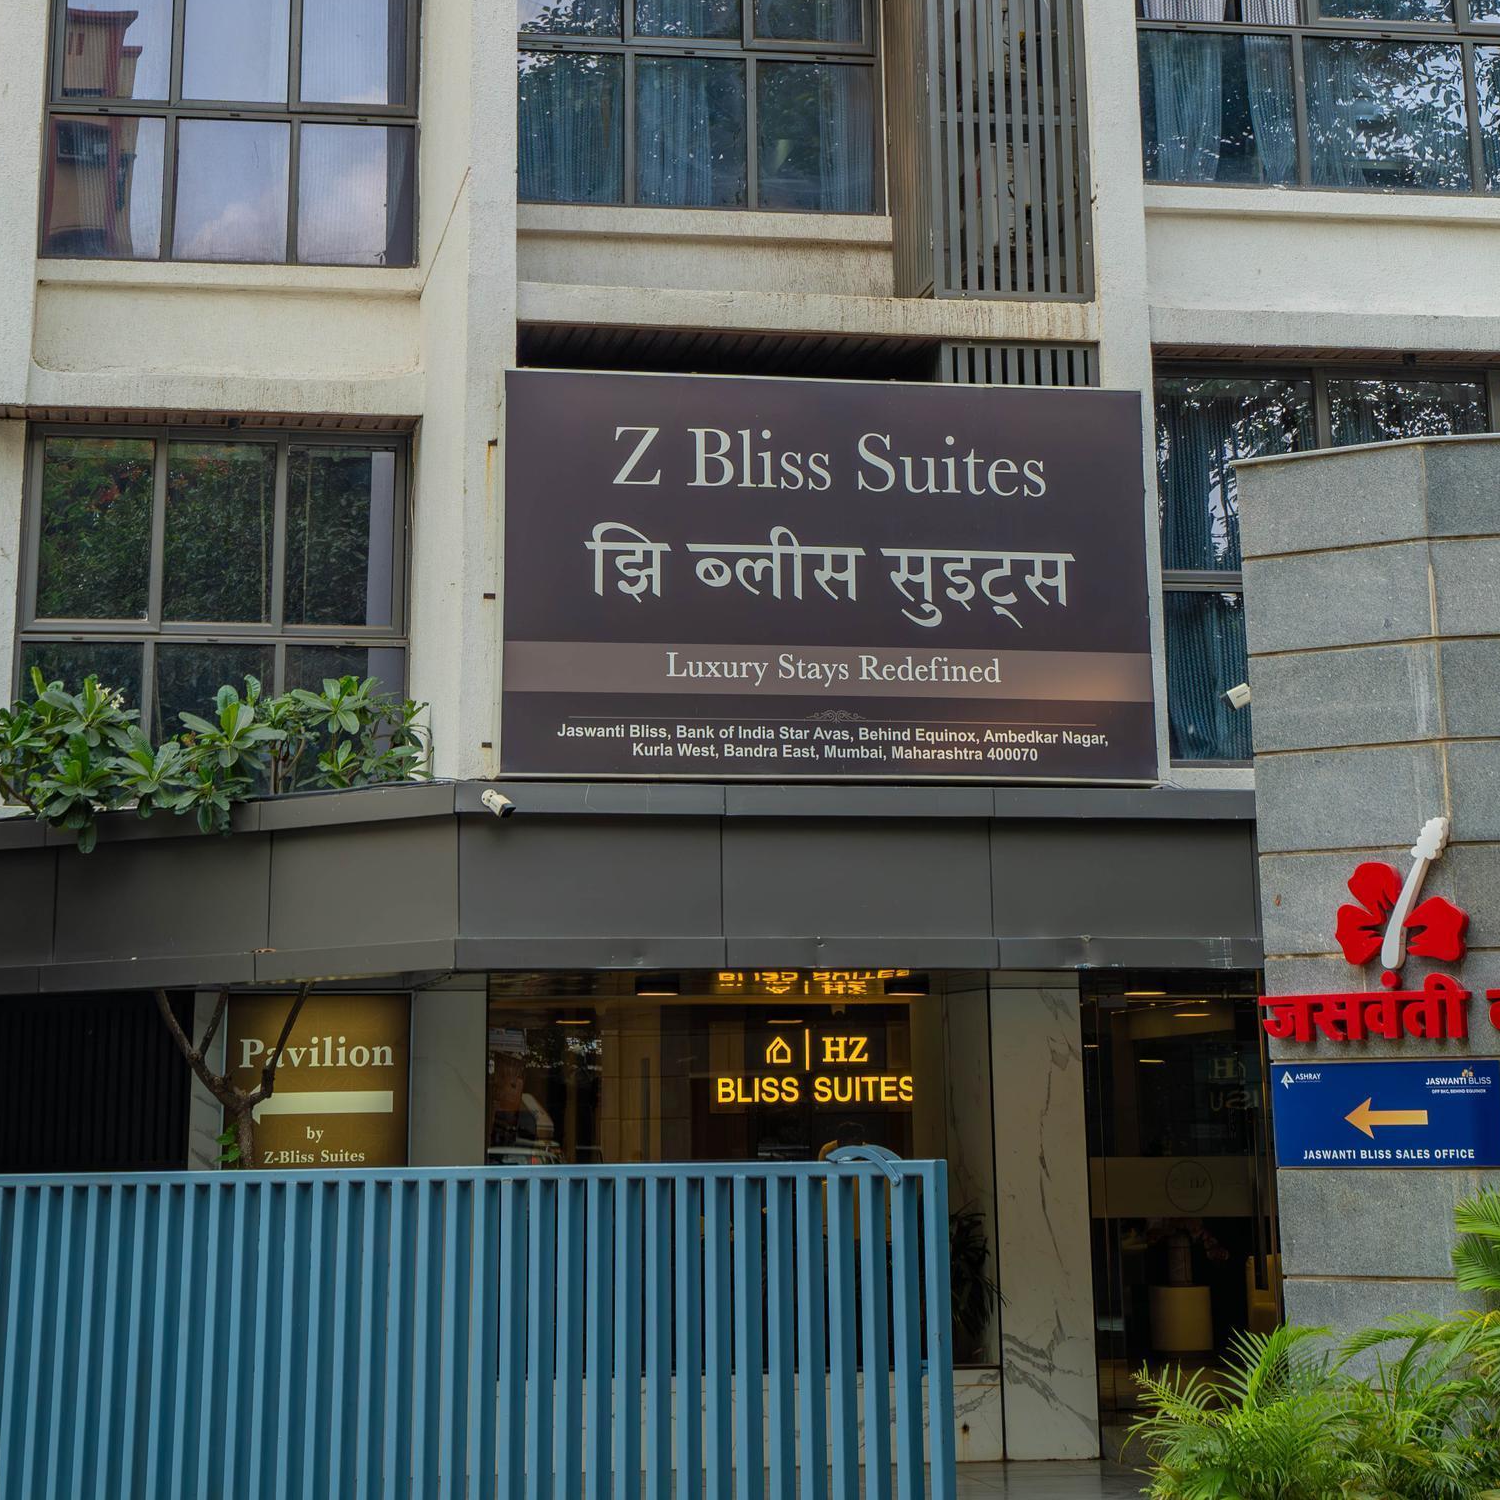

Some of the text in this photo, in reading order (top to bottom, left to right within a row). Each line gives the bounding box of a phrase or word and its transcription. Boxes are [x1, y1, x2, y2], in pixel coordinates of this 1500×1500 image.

[612, 426, 1047, 498] Z Bliss Suites
[584, 521, 1076, 629] झि ब्लीस सुइट्स
[665, 651, 1002, 687] Luxury Stays Redefined
[557, 723, 1109, 748] Jaswanti Bliss, Bank of India Star Avas, Behind Equinox, Ambedkar Nagar,
[633, 743, 1038, 761] Kurla West, Bandra East, Mumbai, Maharashtra 400070
[1259, 969, 1473, 1043] जसवंती
[821, 1036, 869, 1063] HZ
[717, 1075, 913, 1103] BLISS SUITES
[1425, 1076, 1492, 1085] JASWANTI BLISS
[306, 1126, 324, 1143] by
[264, 1149, 365, 1164] Z-Bliss Suites
[1303, 1148, 1475, 1160] JASWANTI BLISS SALES OFFICE
